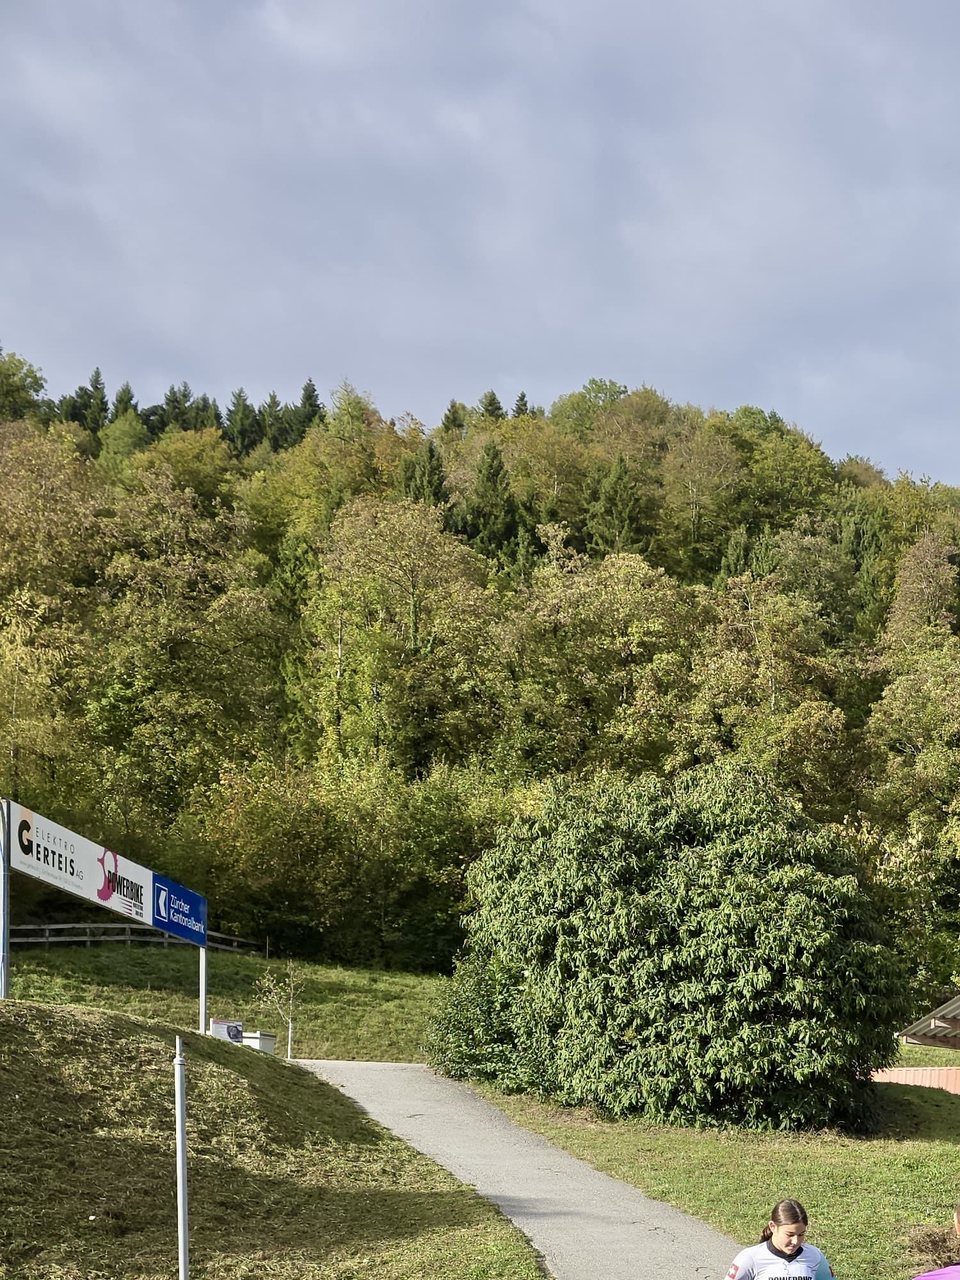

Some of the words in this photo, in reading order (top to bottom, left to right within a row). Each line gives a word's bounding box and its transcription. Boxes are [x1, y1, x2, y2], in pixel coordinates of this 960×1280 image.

[18, 819, 77, 877] GERTEIS
[75, 869, 84, 881] AG
[35, 826, 76, 854] ELEKTRO
[170, 894, 191, 915] Zürcher
[169, 909, 205, 934] Kantonalbank
